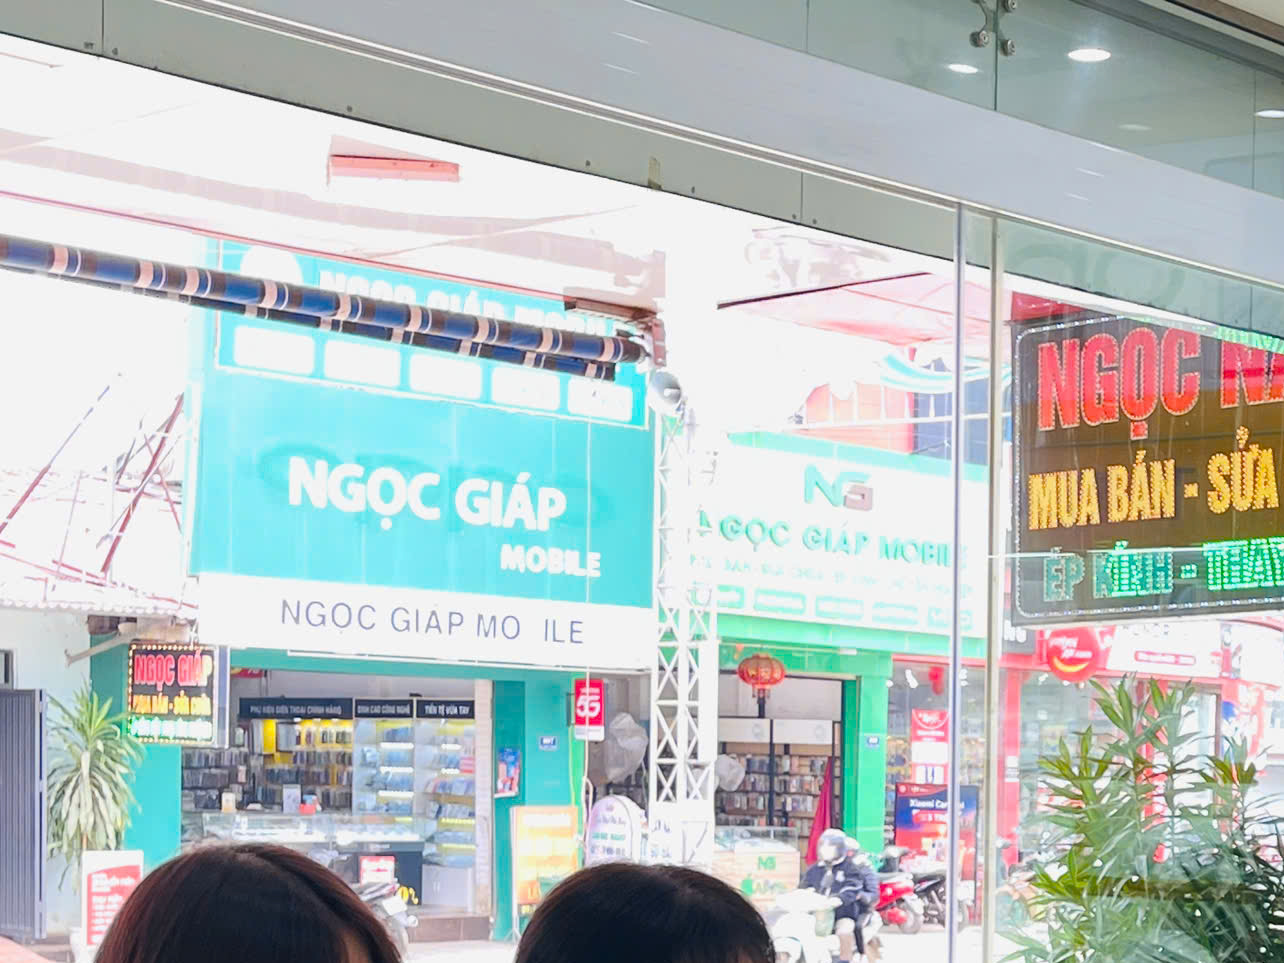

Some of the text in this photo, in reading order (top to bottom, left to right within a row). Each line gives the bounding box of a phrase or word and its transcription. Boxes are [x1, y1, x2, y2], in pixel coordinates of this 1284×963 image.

[1037, 327, 1200, 440] NGỌC
[288, 455, 567, 532] NGỌC GIÁP
[1028, 468, 1101, 530] MUA
[1107, 450, 1176, 523] BÁN
[1207, 425, 1279, 514] SỬA
[500, 544, 601, 577] MOBILE
